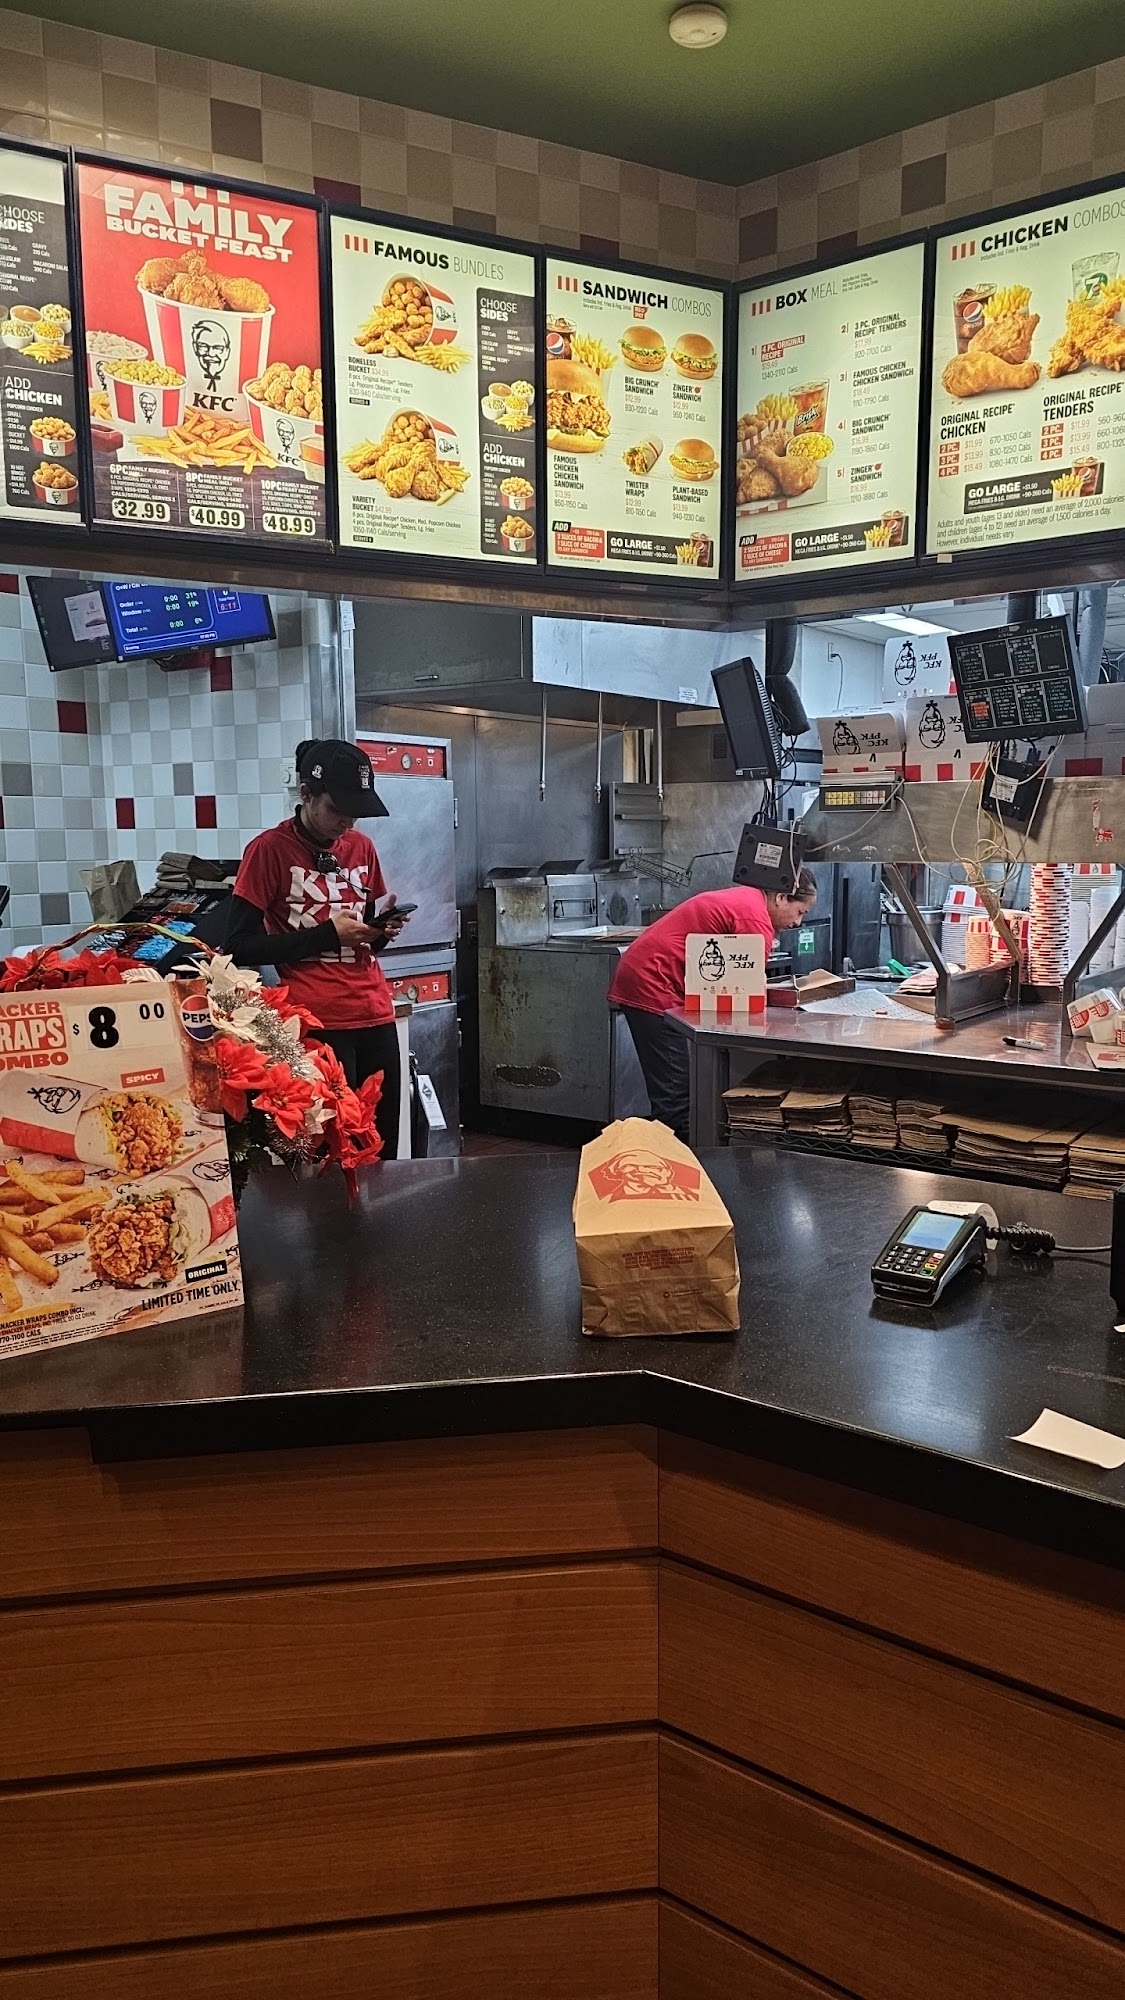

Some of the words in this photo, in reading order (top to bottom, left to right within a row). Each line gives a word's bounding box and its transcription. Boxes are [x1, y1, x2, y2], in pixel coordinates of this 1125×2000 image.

[104, 183, 293, 247] FAMILY
[981, 215, 1069, 253] CHICKEN
[1073, 200, 1125, 229] COMBOS
[106, 216, 209, 248] BUCKET
[215, 237, 293, 263] FEAST
[374, 241, 449, 270] FAMOUS
[453, 256, 504, 281] BUNDLES
[583, 280, 668, 310] SANDWICH
[671, 297, 712, 317] COMBOS
[775, 288, 808, 310] BOX
[811, 281, 838, 301] MEAL
[480, 297, 518, 314] CHOOSE
[480, 308, 509, 322] SIDES
[841, 324, 847, 333] 2
[855, 322, 859, 330] 3
[871, 313, 901, 326] ORIGINAL
[855, 327, 876, 339] RECIPE
[879, 320, 907, 333] TENDERS
[777, 336, 804, 349] ORIGINAL
[348, 356, 377, 367] BONELESS
[348, 365, 370, 374] BUCKET
[840, 373, 845, 382] 3
[853, 367, 878, 379] FAMOUS
[879, 361, 906, 373] CHICKEN
[5, 376, 32, 390] ADD
[625, 376, 634, 385] BIG
[636, 378, 659, 388] CRUNCH
[853, 375, 880, 387] CHICKEN
[881, 368, 914, 381] SANDWICH
[625, 384, 654, 396] SANDWICH
[673, 383, 693, 393] ZINGER
[1043, 389, 1086, 407] ORIGINAL
[1089, 382, 1122, 398] RECIPE
[5, 388, 63, 406] CHICKEN
[192, 392, 235, 412] KFC
[673, 391, 702, 402] SANDWICH
[941, 410, 980, 426] ORIGINAL
[983, 403, 1014, 418] RECIPE
[1043, 401, 1094, 421] TENDERS
[838, 422, 843, 430] 4
[852, 419, 863, 428] BIG
[864, 413, 890, 426] CRUNCH
[1050, 425, 1062, 434] PC.
[1071, 419, 1090, 430] $11.99
[852, 423, 884, 436] SANDWICH
[940, 421, 986, 440] CHICKEN
[947, 443, 958, 452] PC.
[1019, 430, 1032, 439] Cals
[1043, 439, 1049, 447] 3
[1049, 437, 1062, 446] PC.
[1070, 432, 1091, 443] $13.99
[483, 443, 503, 454] ADD
[946, 455, 958, 464] PC.
[1018, 443, 1032, 452] Cals
[1042, 451, 1048, 459] 4
[1049, 450, 1061, 458] PC.
[278, 453, 301, 466] KFC
[483, 453, 525, 468] CHICKEN
[553, 454, 577, 465] FAMOUS
[940, 469, 946, 477] 4
[946, 467, 957, 476] PC.
[1020, 454, 1033, 463] Cals
[110, 464, 128, 474] 6PC
[553, 463, 579, 473] CHICKEN
[837, 469, 842, 478] 5
[851, 464, 873, 476] ZINGER
[186, 472, 204, 483] 8PC
[553, 471, 579, 481] CHICKEN
[850, 471, 883, 484] SANDWICH
[261, 480, 281, 491] 10PC
[554, 480, 584, 490] SANDWICH
[625, 480, 649, 490] TWISTER
[672, 485, 709, 497] PLANT-BASED
[968, 488, 984, 499] GO
[986, 481, 1021, 496] LARGE
[352, 496, 376, 504] VARIETY
[625, 488, 645, 498] WRAPS
[672, 493, 701, 503] SANDWICH
[113, 500, 165, 519] $32.99
[352, 503, 374, 512] BUCKET
[191, 508, 240, 527] $40.99
[264, 515, 313, 533] $48.99
[554, 522, 569, 532] ADD
[610, 537, 623, 547] GO
[624, 539, 653, 550] LARGE
[741, 536, 755, 545] ADD
[795, 538, 808, 548] GO
[809, 533, 839, 545] LARGE
[960, 533, 985, 544] individual
[986, 531, 1002, 541] needs
[121, 609, 142, 617] Window
[165, 603, 180, 611] 0:00
[220, 602, 236, 611] 6:11
[169, 620, 184, 628] 0:00
[923, 660, 942, 670] KFC
[867, 739, 889, 747] KFC
[286, 865, 369, 902] KFC
[183, 1012, 212, 1023] PEPS
[72, 1023, 80, 1036] $
[88, 1006, 119, 1049] 8
[139, 1003, 165, 1020] 00
[0, 1017, 64, 1051] RAPS
[126, 1072, 159, 1085] SPICY
[188, 1264, 225, 1279] ORIGINAL
[141, 1292, 184, 1312] LIMITED
[186, 1286, 211, 1300] TIME
[26, 1314, 47, 1324] WRAPS
[48, 1309, 69, 1320] COMBO
[70, 1307, 85, 1315] INCL:
[26, 1329, 41, 1338] CALS
